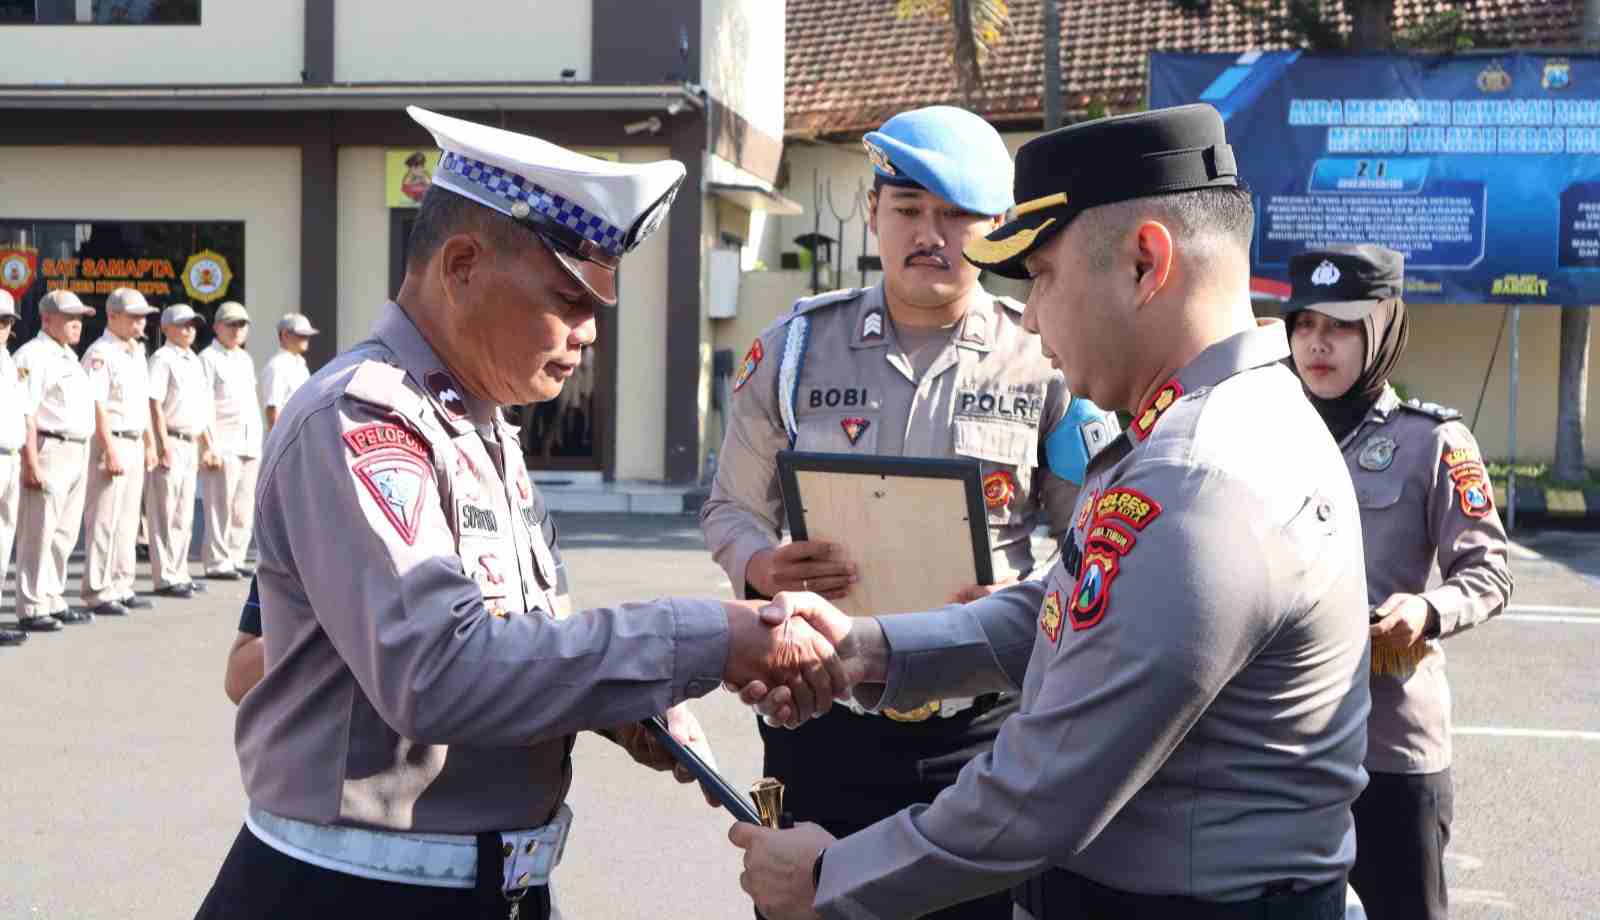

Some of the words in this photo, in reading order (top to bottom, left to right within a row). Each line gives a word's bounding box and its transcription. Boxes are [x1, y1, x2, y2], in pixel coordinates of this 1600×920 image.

[42, 258, 78, 276] SAT
[82, 258, 175, 279] SAMAPTA
[809, 388, 867, 408] BOBI
[961, 393, 1033, 418] POLRI
